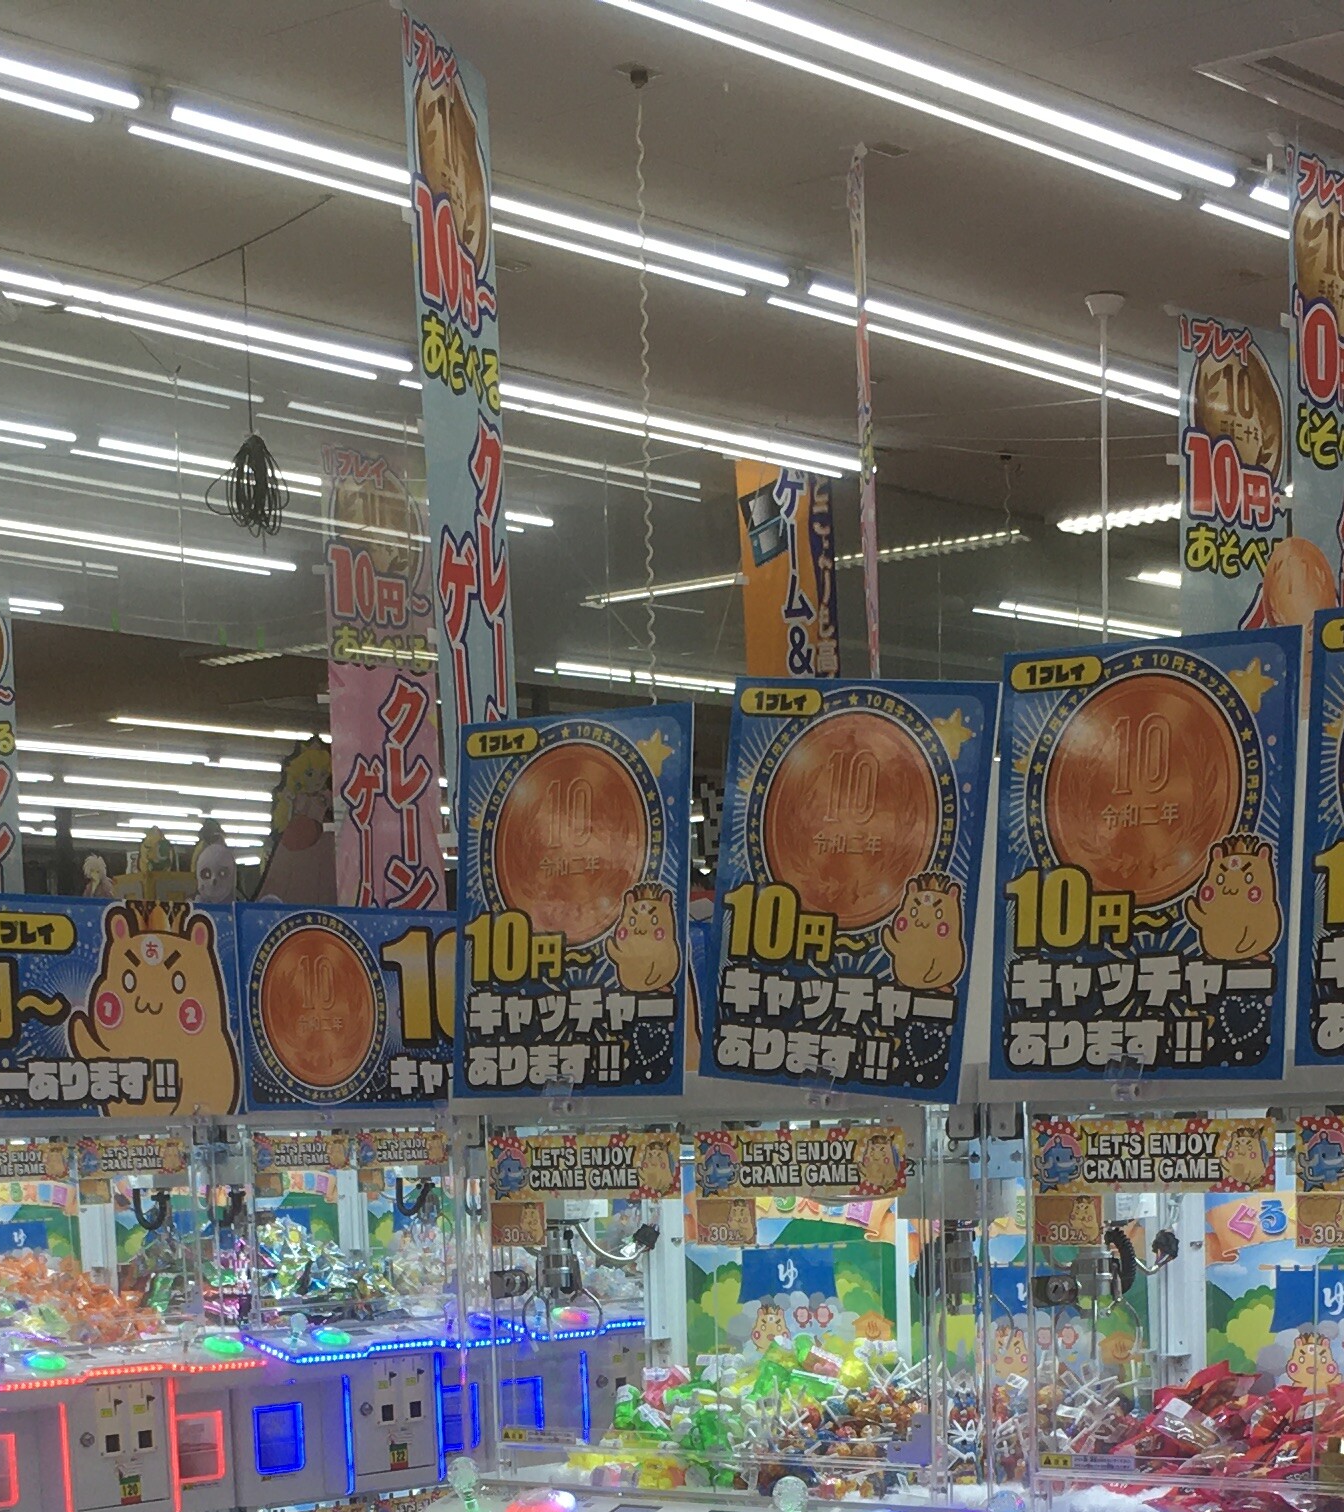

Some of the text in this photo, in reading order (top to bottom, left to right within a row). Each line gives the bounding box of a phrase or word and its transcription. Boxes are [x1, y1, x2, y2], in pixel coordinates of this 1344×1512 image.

[1026, 662, 1085, 685] 1プレイ
[753, 692, 808, 712] 1プレイ
[478, 734, 525, 753] 1プレイ
[1112, 712, 1171, 796] 10
[823, 749, 882, 823] 10
[1101, 803, 1180, 827] 令和二年
[1008, 954, 1276, 1010] キャッチャー
[721, 967, 955, 1025] キャッチャー
[469, 989, 675, 1035] キャッチャー
[1087, 1132, 1217, 1156] LET'S ENJOY
[1082, 1156, 1221, 1182] CRANE GAME
